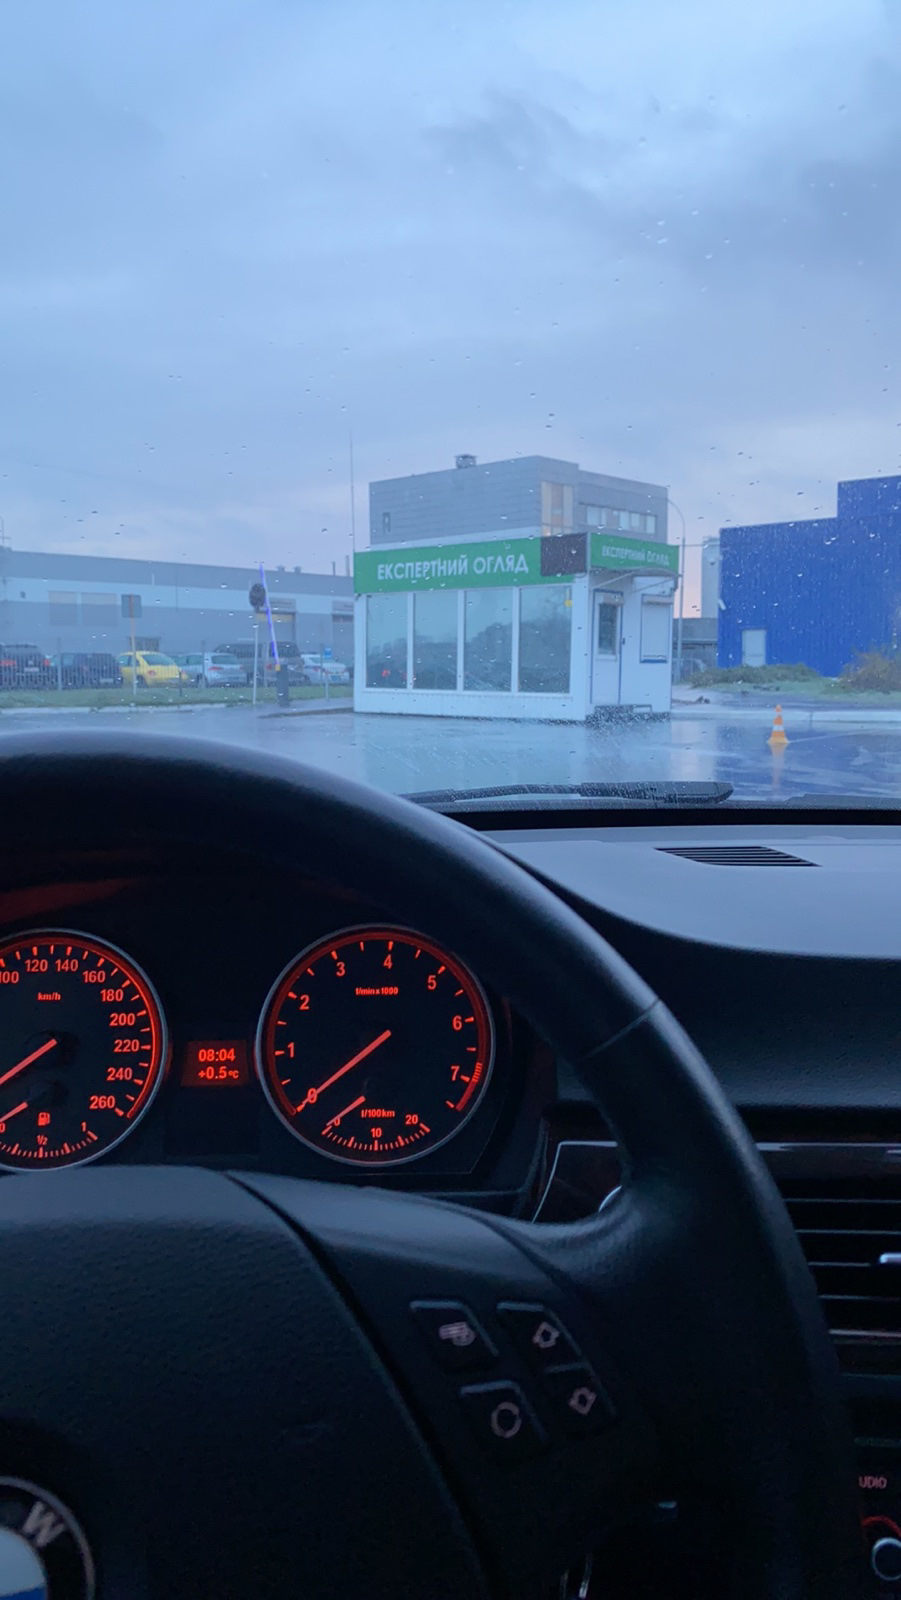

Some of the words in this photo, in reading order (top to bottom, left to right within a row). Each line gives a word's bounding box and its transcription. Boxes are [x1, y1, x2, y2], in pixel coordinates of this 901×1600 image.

[377, 554, 468, 580] ЕКСПЕРТНИЙ
[473, 553, 529, 574] ОГЛЯД
[25, 959, 48, 972] 120
[55, 959, 78, 972] 140
[383, 954, 393, 969] 4
[336, 962, 346, 977] 3
[83, 971, 106, 983] 160
[428, 975, 437, 990] 5
[37, 992, 61, 1001] km/h
[100, 989, 124, 1002] 180
[300, 995, 310, 1010] 2
[109, 1013, 136, 1027] 200
[452, 1015, 462, 1031] 6
[114, 1039, 140, 1053] 220
[287, 1042, 295, 1058] 1
[198, 1048, 235, 1062] 08:04
[107, 1068, 133, 1081] 240
[451, 1065, 460, 1081] 7
[90, 1096, 116, 1109] 260
[307, 1087, 317, 1104] 0
[81, 1121, 86, 1132] 1
[405, 1114, 419, 1125] 20
[370, 1127, 382, 1138] 10
